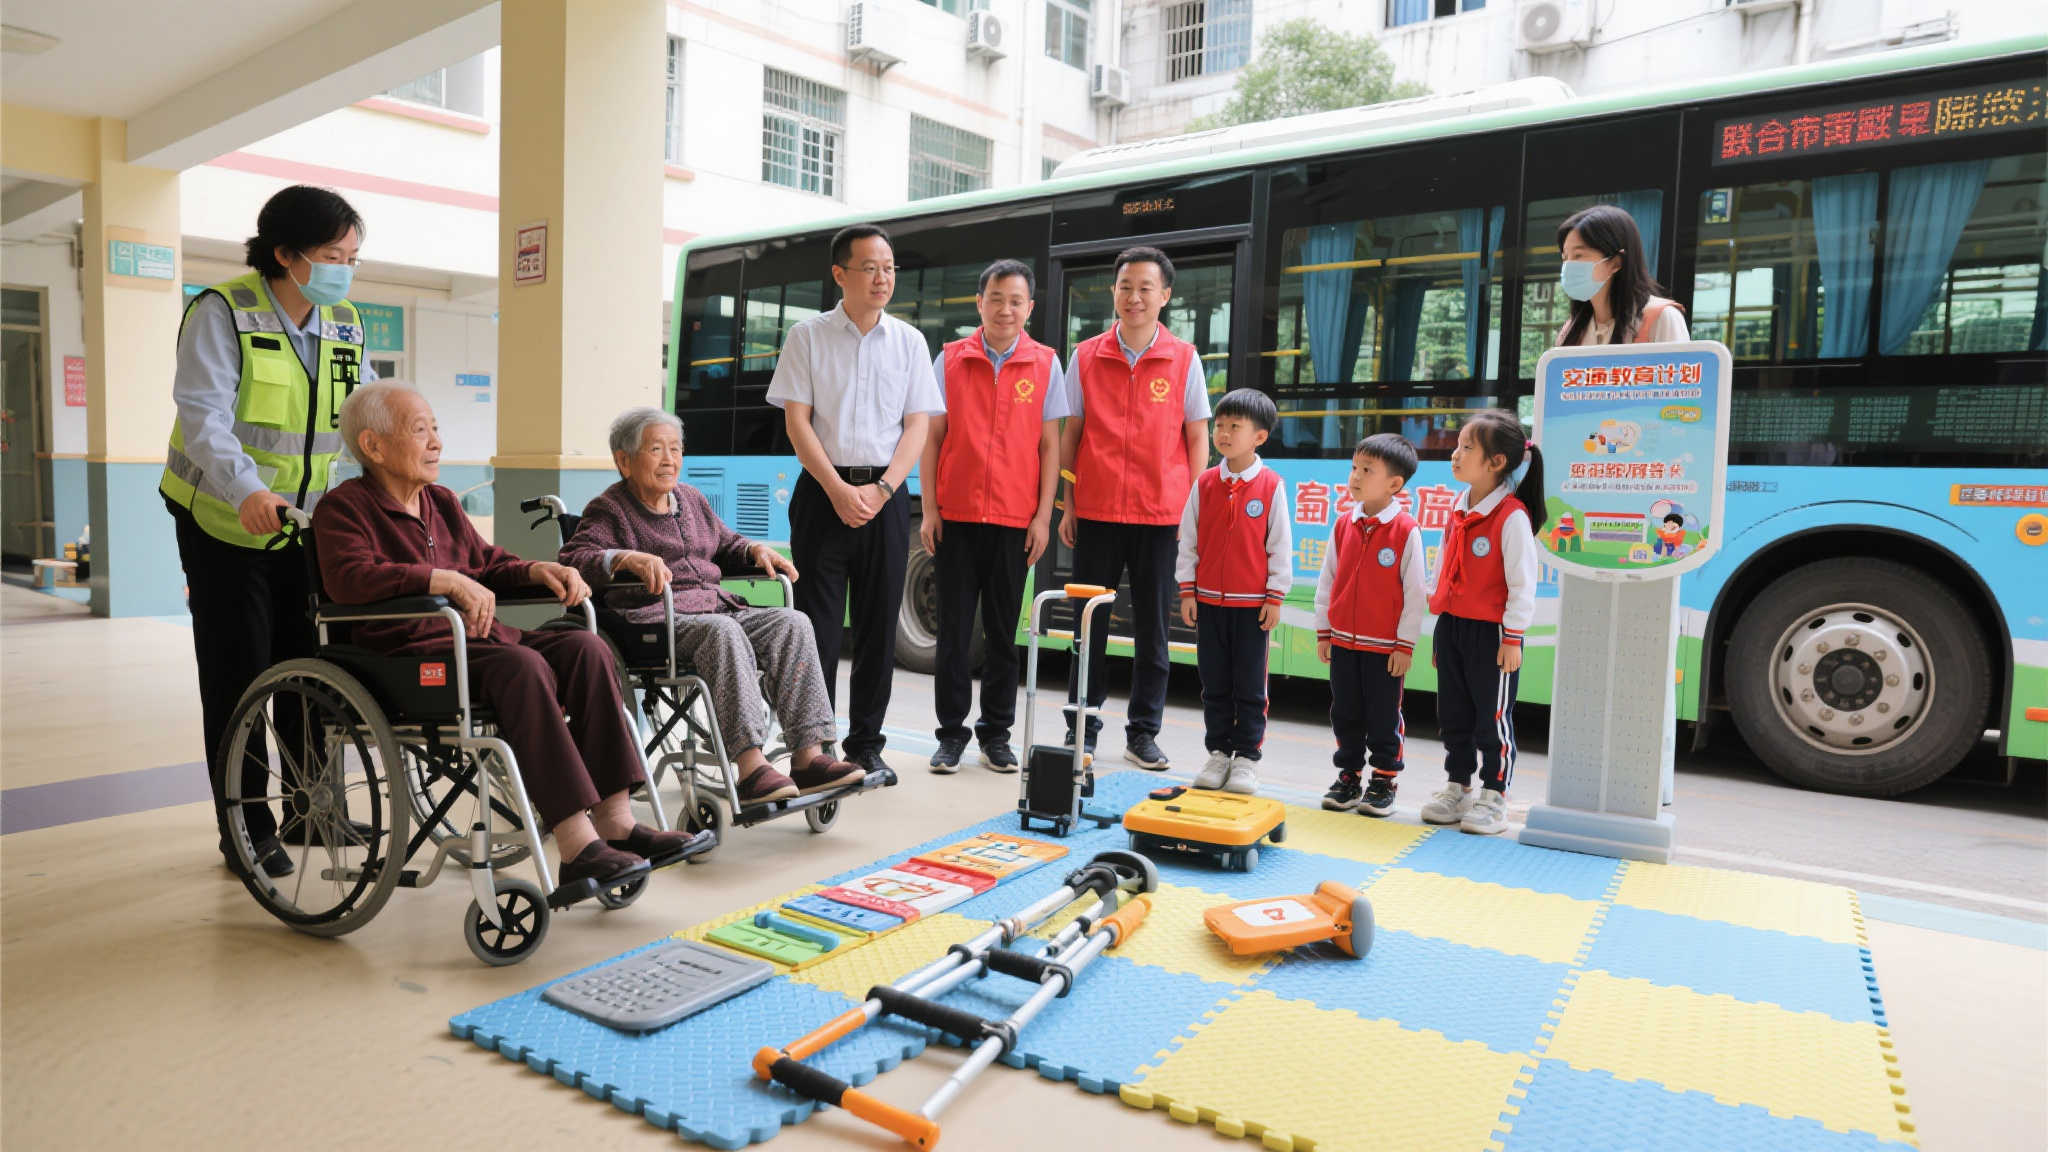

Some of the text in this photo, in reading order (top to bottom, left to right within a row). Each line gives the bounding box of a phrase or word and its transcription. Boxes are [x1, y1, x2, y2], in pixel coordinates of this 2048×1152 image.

[1562, 363, 1702, 388] 交通教育计划
